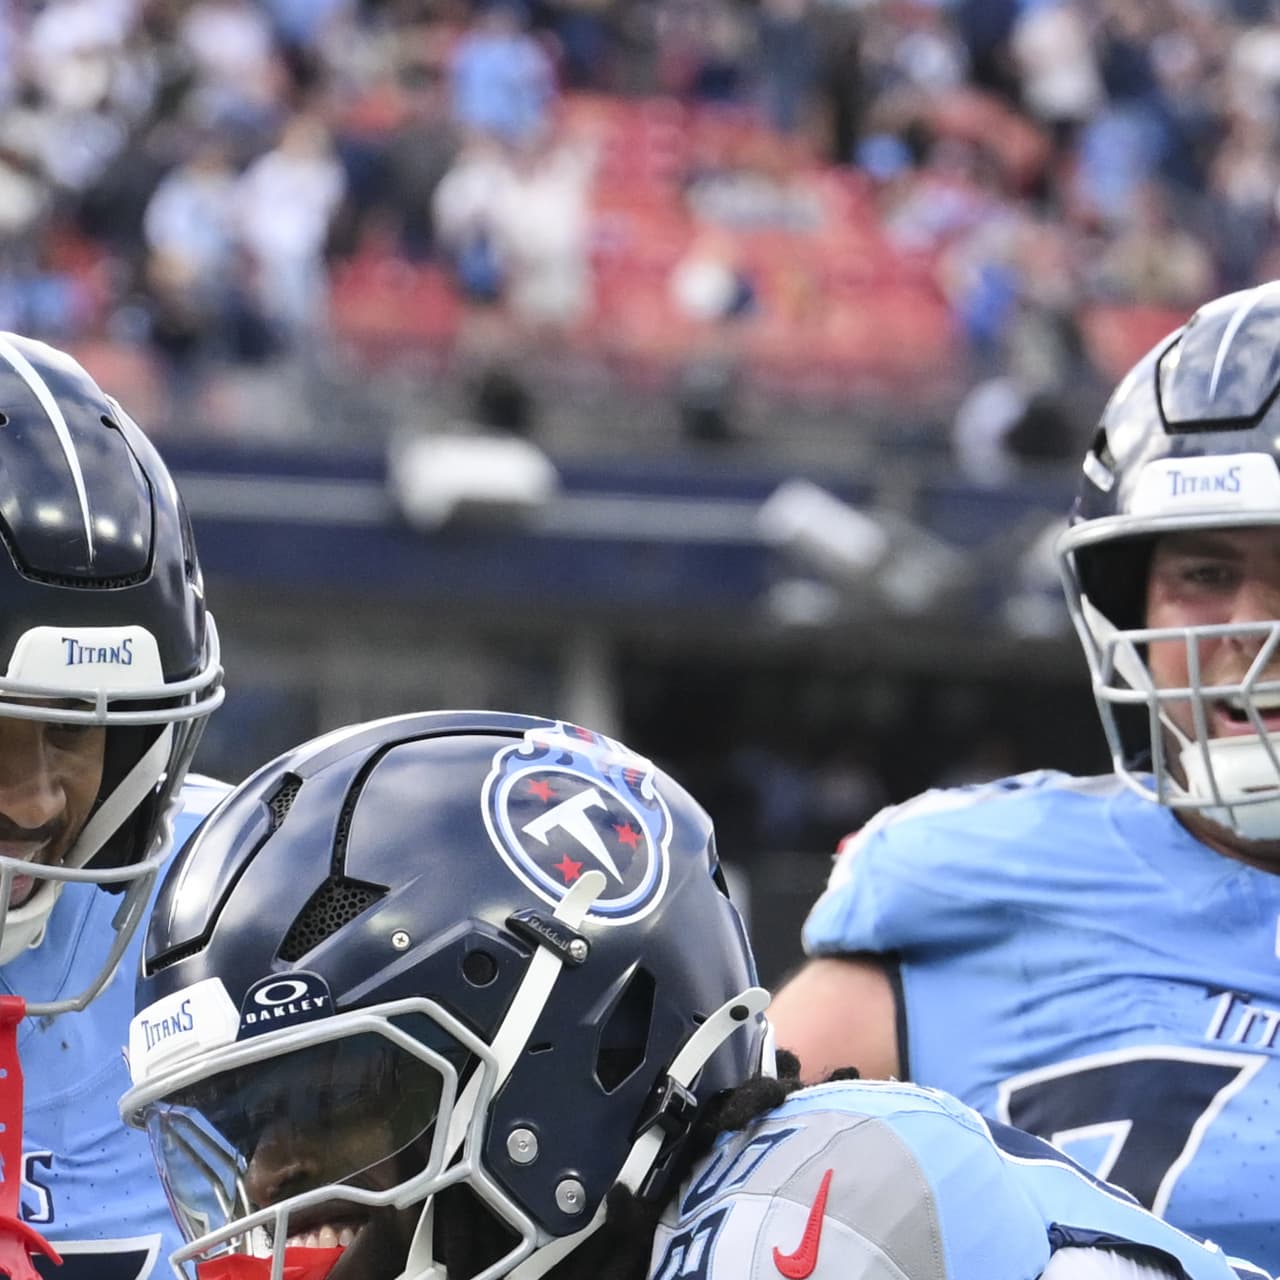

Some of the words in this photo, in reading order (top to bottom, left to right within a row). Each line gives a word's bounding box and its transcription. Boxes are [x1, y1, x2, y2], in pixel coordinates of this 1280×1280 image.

[1166, 464, 1242, 497] TITANS
[61, 636, 132, 665] TITANS
[140, 998, 193, 1051] TITANS
[245, 995, 325, 1024] OAKLEY
